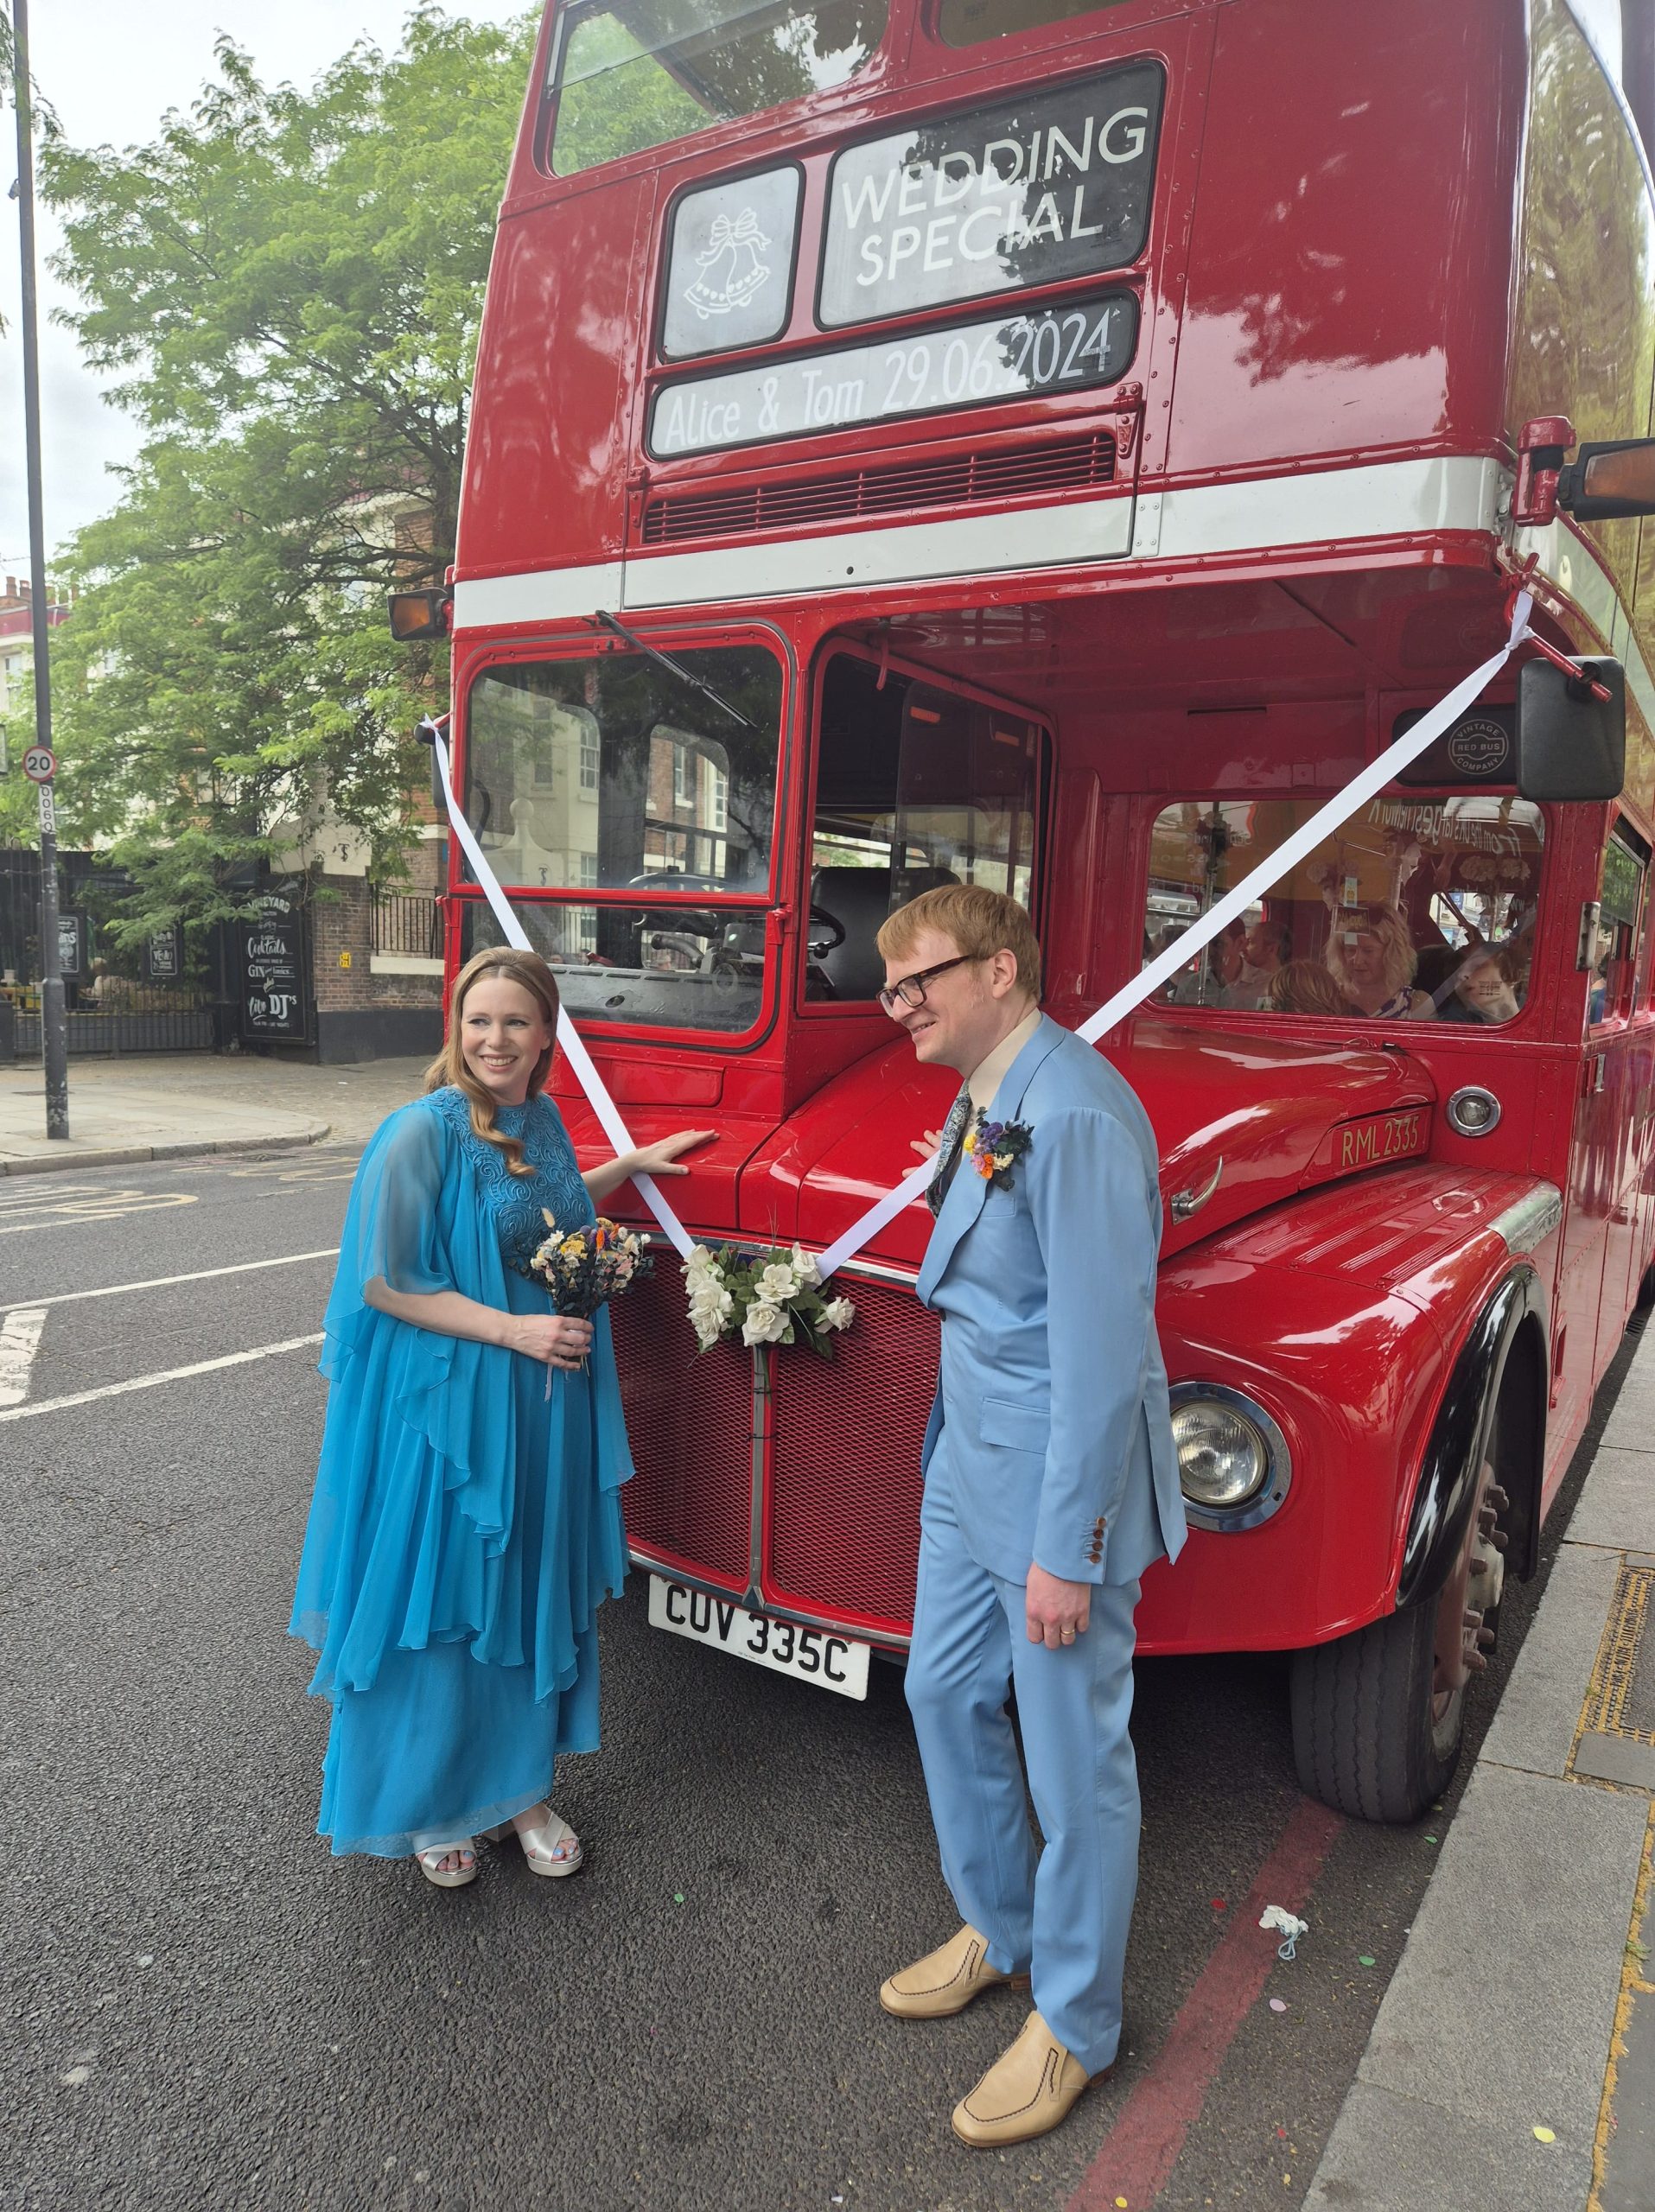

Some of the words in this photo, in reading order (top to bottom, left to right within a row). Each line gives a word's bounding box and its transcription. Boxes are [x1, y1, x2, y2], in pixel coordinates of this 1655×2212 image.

[842, 106, 1149, 230] WEDDING
[856, 185, 1103, 286] SPECIAL
[665, 395, 741, 449] Alice
[758, 378, 779, 430] &
[802, 369, 863, 425] Tom
[882, 308, 1111, 412] 29.06.2024
[28, 756, 50, 771] 20
[1457, 723, 1500, 737] VINTAGE
[1457, 757, 1499, 771] COMPANY
[1342, 1125, 1380, 1166] RML
[1384, 1116, 1419, 1156] 2335
[666, 1585, 735, 1642] CUV
[747, 1612, 848, 1683] 335C
